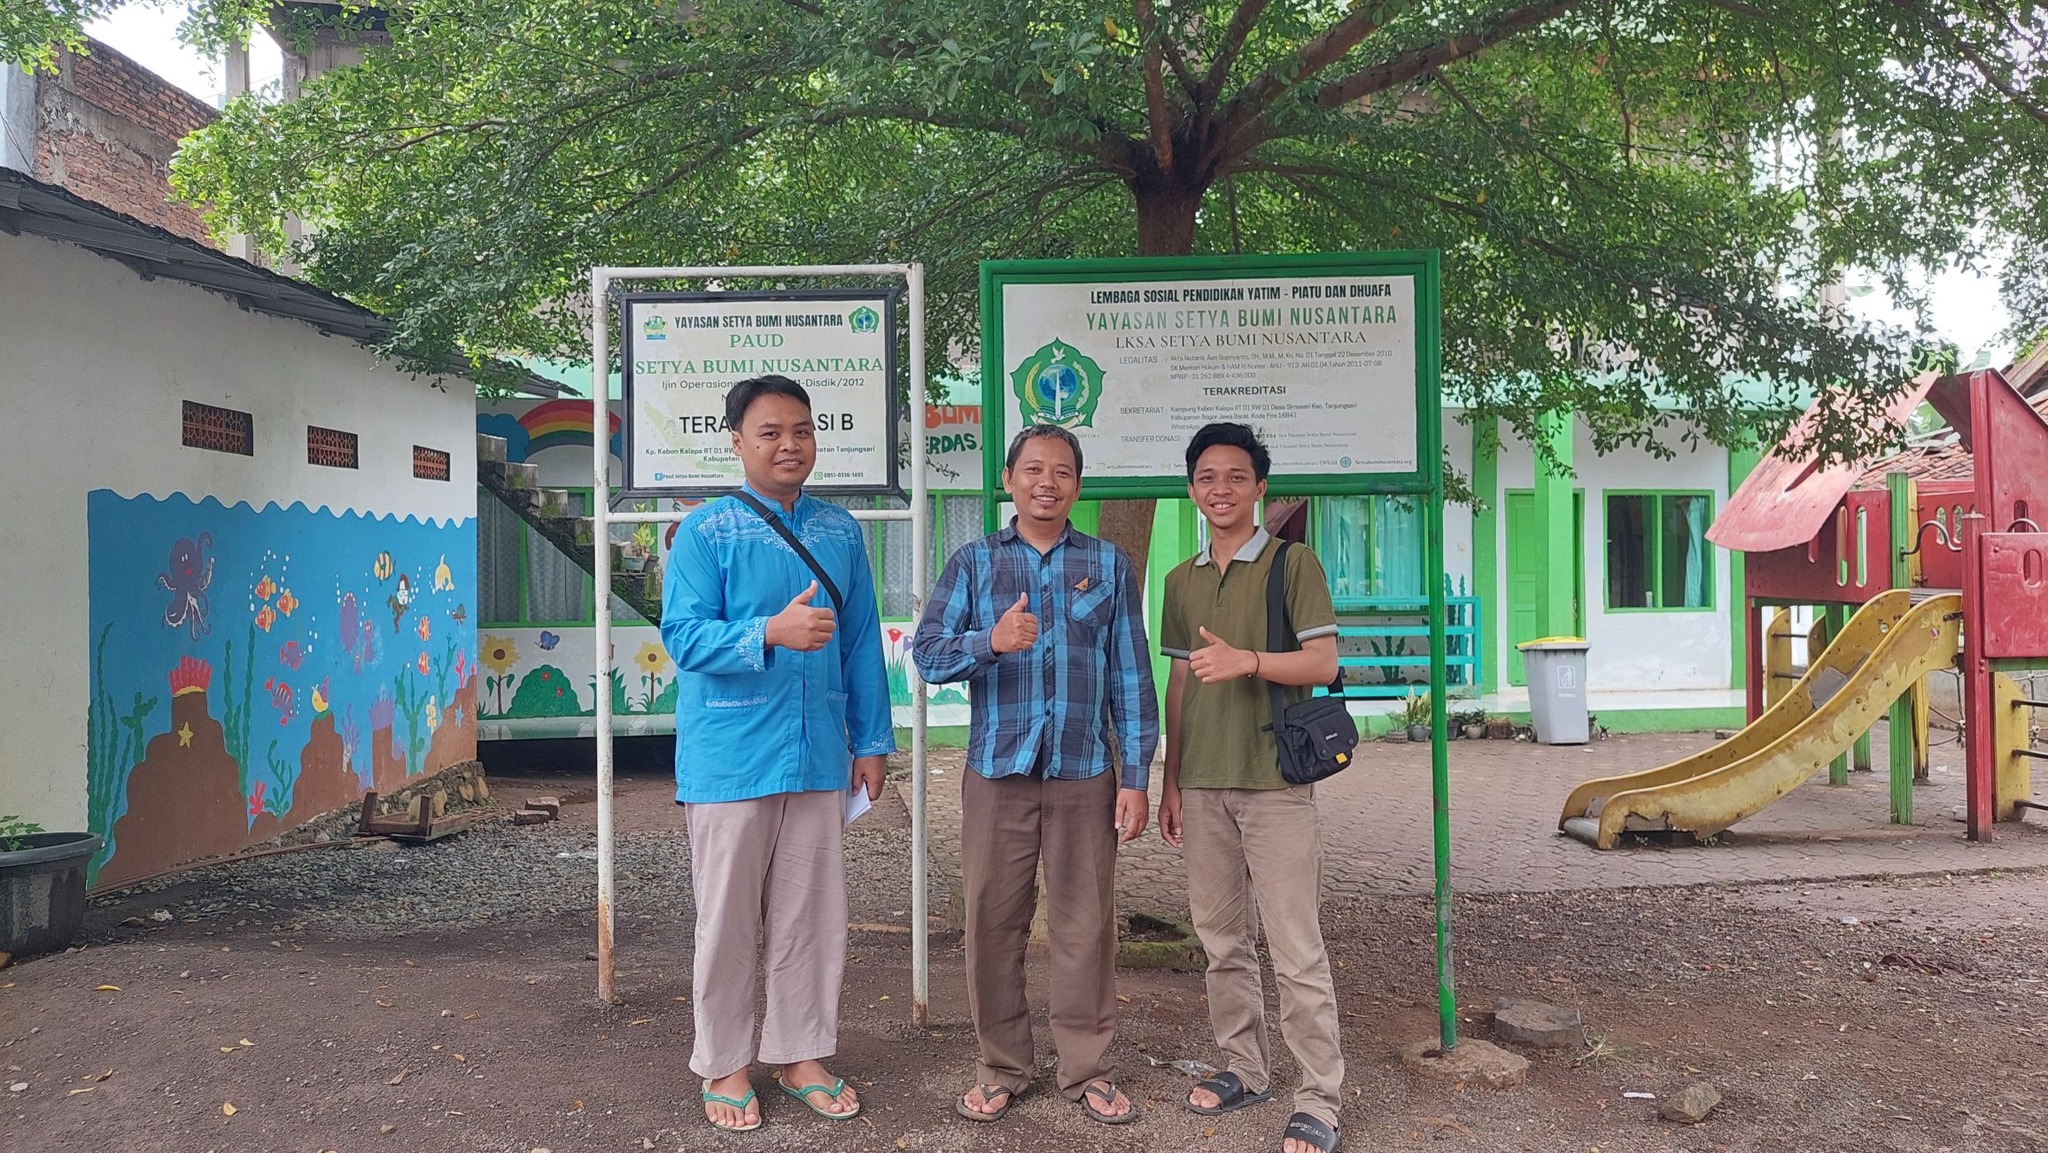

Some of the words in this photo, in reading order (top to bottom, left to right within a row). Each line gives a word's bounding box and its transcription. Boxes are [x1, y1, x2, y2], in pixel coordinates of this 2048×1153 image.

[1091, 290, 1140, 304] LEMBAGA
[1143, 289, 1180, 303] SOSIAL
[1183, 288, 1244, 302] PENDIDIKAN
[1247, 287, 1281, 300] YATIM
[1292, 285, 1322, 299] PIATU
[1325, 285, 1347, 298] DAN
[1350, 284, 1392, 298] DHUAFA
[675, 316, 719, 329] YAYASAN
[723, 315, 753, 328] SETYA
[756, 315, 782, 327] BUMI
[785, 314, 843, 327] NUSANTARA
[1086, 312, 1167, 331] YAYASAN
[1175, 310, 1230, 329] SETYA
[1238, 308, 1282, 327] BUMI
[1290, 305, 1397, 326] NUSANTARA
[730, 334, 784, 348] PAUD
[1116, 336, 1156, 349] LKSA
[1160, 335, 1212, 348] SETYA
[1216, 333, 1256, 347] BUMI
[1262, 331, 1367, 345] NUSANTARA
[635, 360, 697, 375] SETYA
[703, 359, 755, 373] BUMI
[761, 358, 884, 372] NUSANTARA
[1120, 356, 1158, 364] LEGALITAS
[662, 380, 677, 391] Ijin
[1203, 386, 1286, 396] TERAKREDITASI
[1120, 407, 1164, 415] SEKRETARIAT
[842, 414, 854, 430] B
[680, 448, 703, 456] Kalapa
[836, 445, 875, 454] Tanjungsari
[703, 455, 740, 463] Kabupaten
